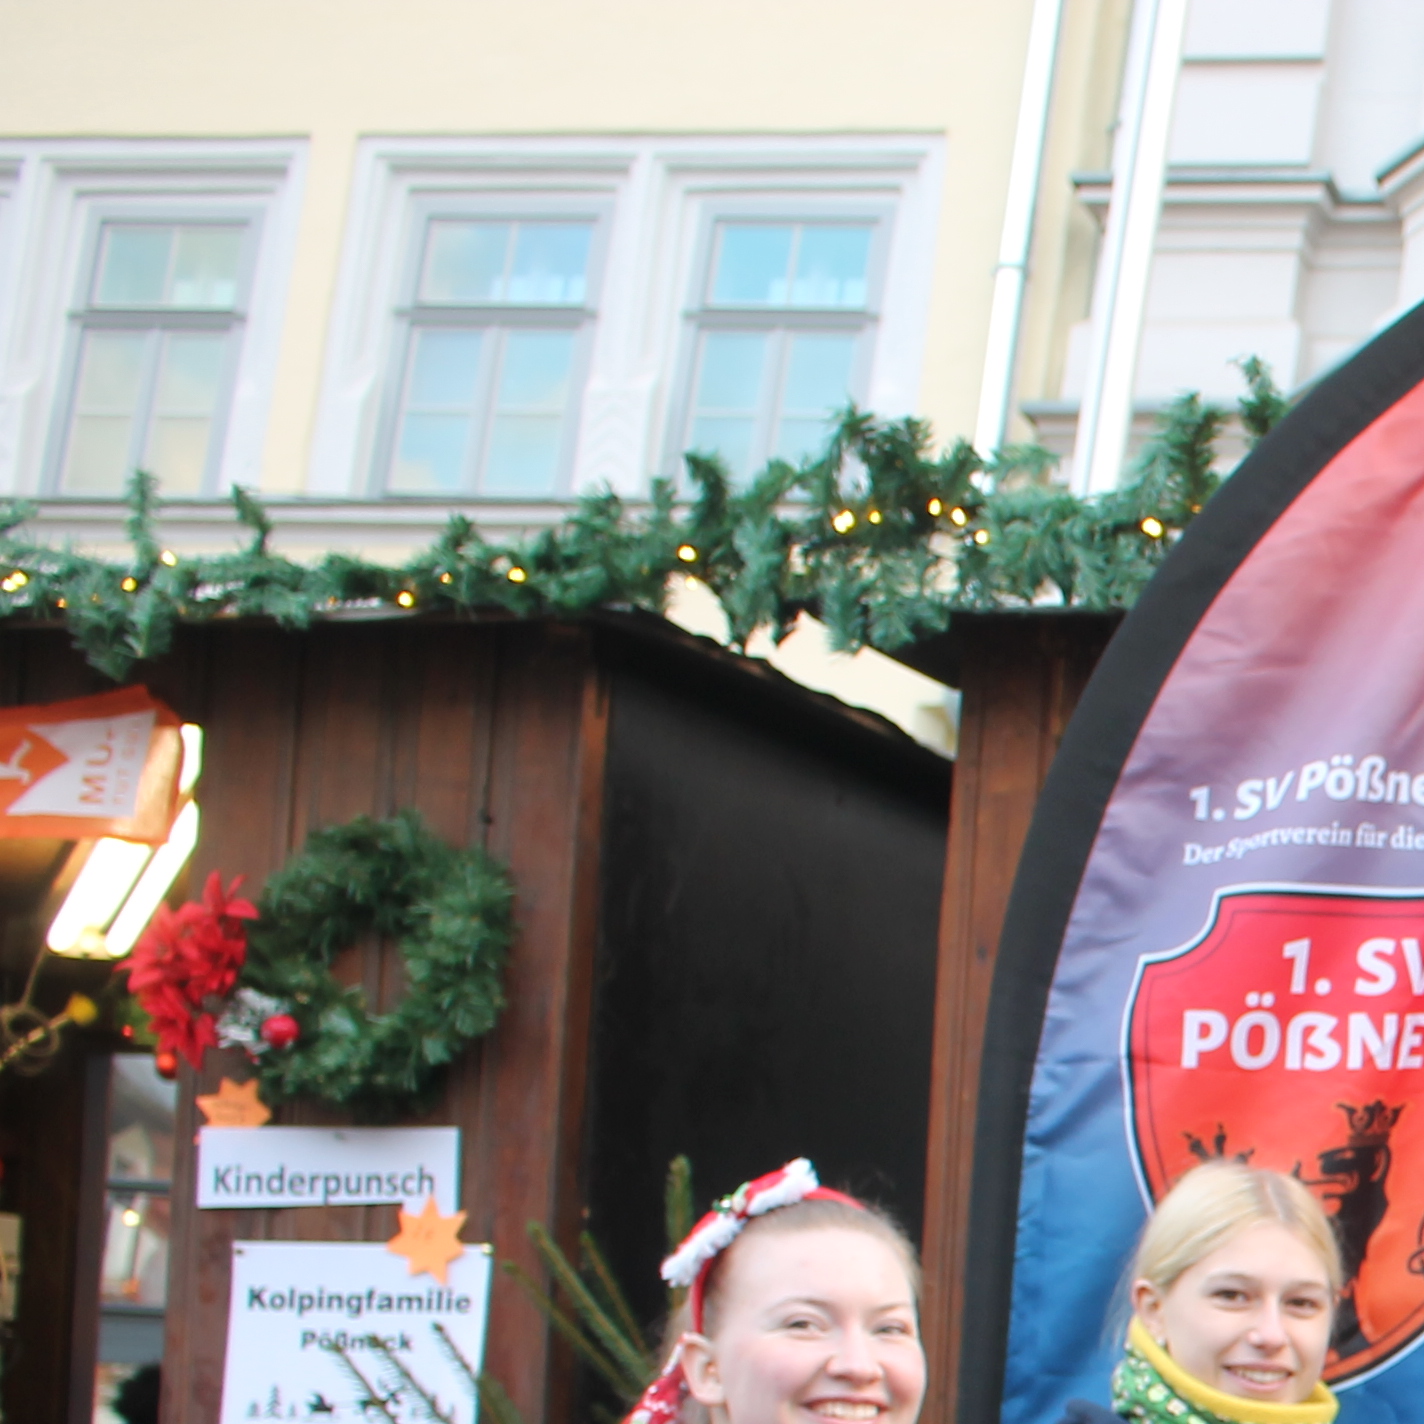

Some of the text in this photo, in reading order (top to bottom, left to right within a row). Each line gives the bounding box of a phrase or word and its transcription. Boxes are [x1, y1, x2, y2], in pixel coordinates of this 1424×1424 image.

[1190, 785, 1225, 821] 1.
[1233, 770, 1296, 821] SV
[1182, 842, 1224, 867] Der
[1226, 821, 1352, 861] Sportverein
[1353, 821, 1387, 849] für
[1282, 937, 1333, 996] 1.
[213, 1164, 435, 1206] Kinderpunsch
[247, 1287, 472, 1318] Kolpingfamilie
[301, 1329, 413, 1351] Pößnck
